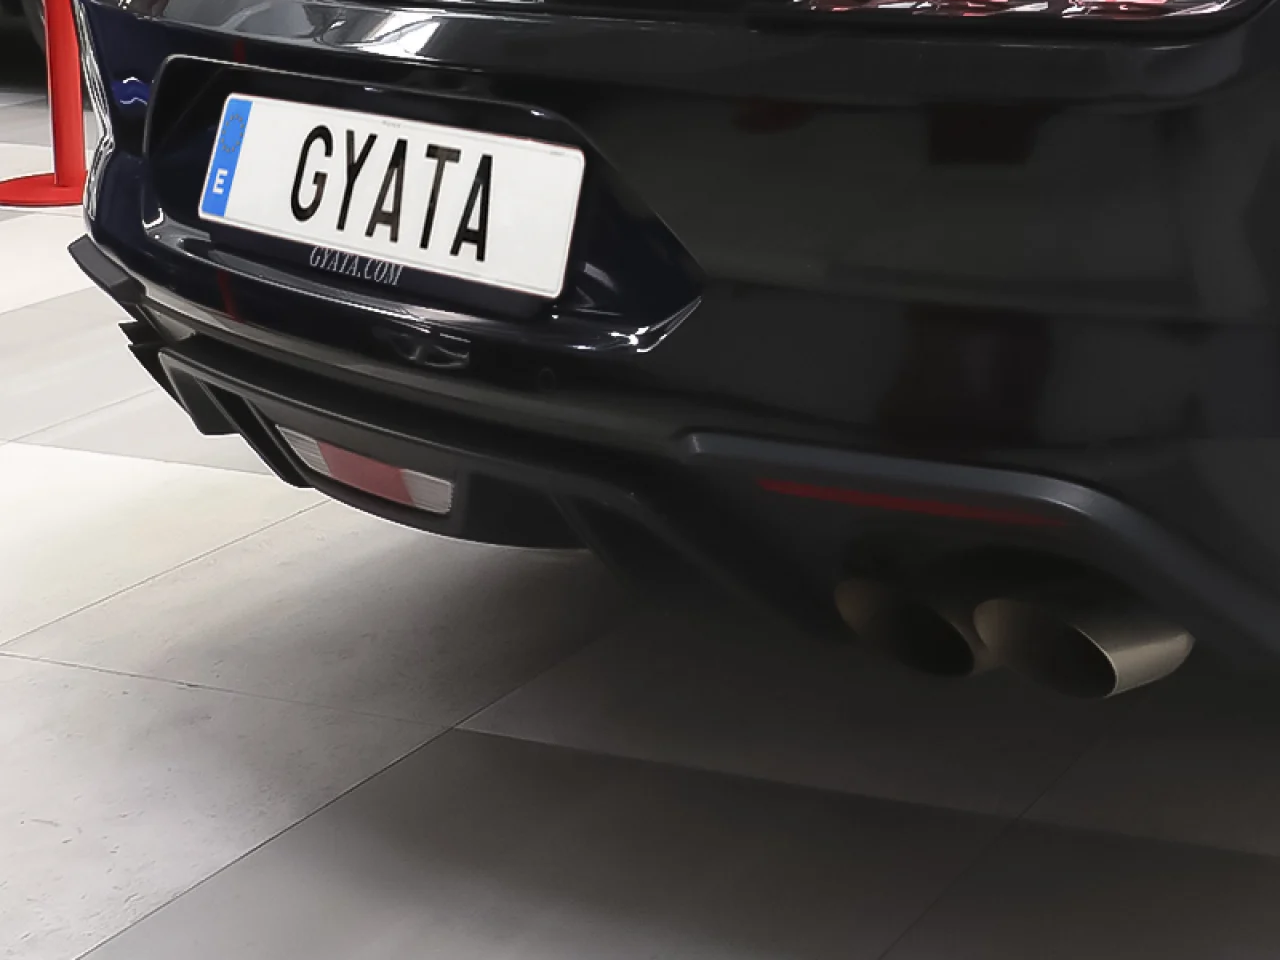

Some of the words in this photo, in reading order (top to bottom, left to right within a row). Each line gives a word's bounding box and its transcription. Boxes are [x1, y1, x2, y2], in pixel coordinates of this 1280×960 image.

[212, 167, 228, 194] E
[290, 125, 493, 261] GYATA
[309, 245, 404, 286] GYATA.COM
